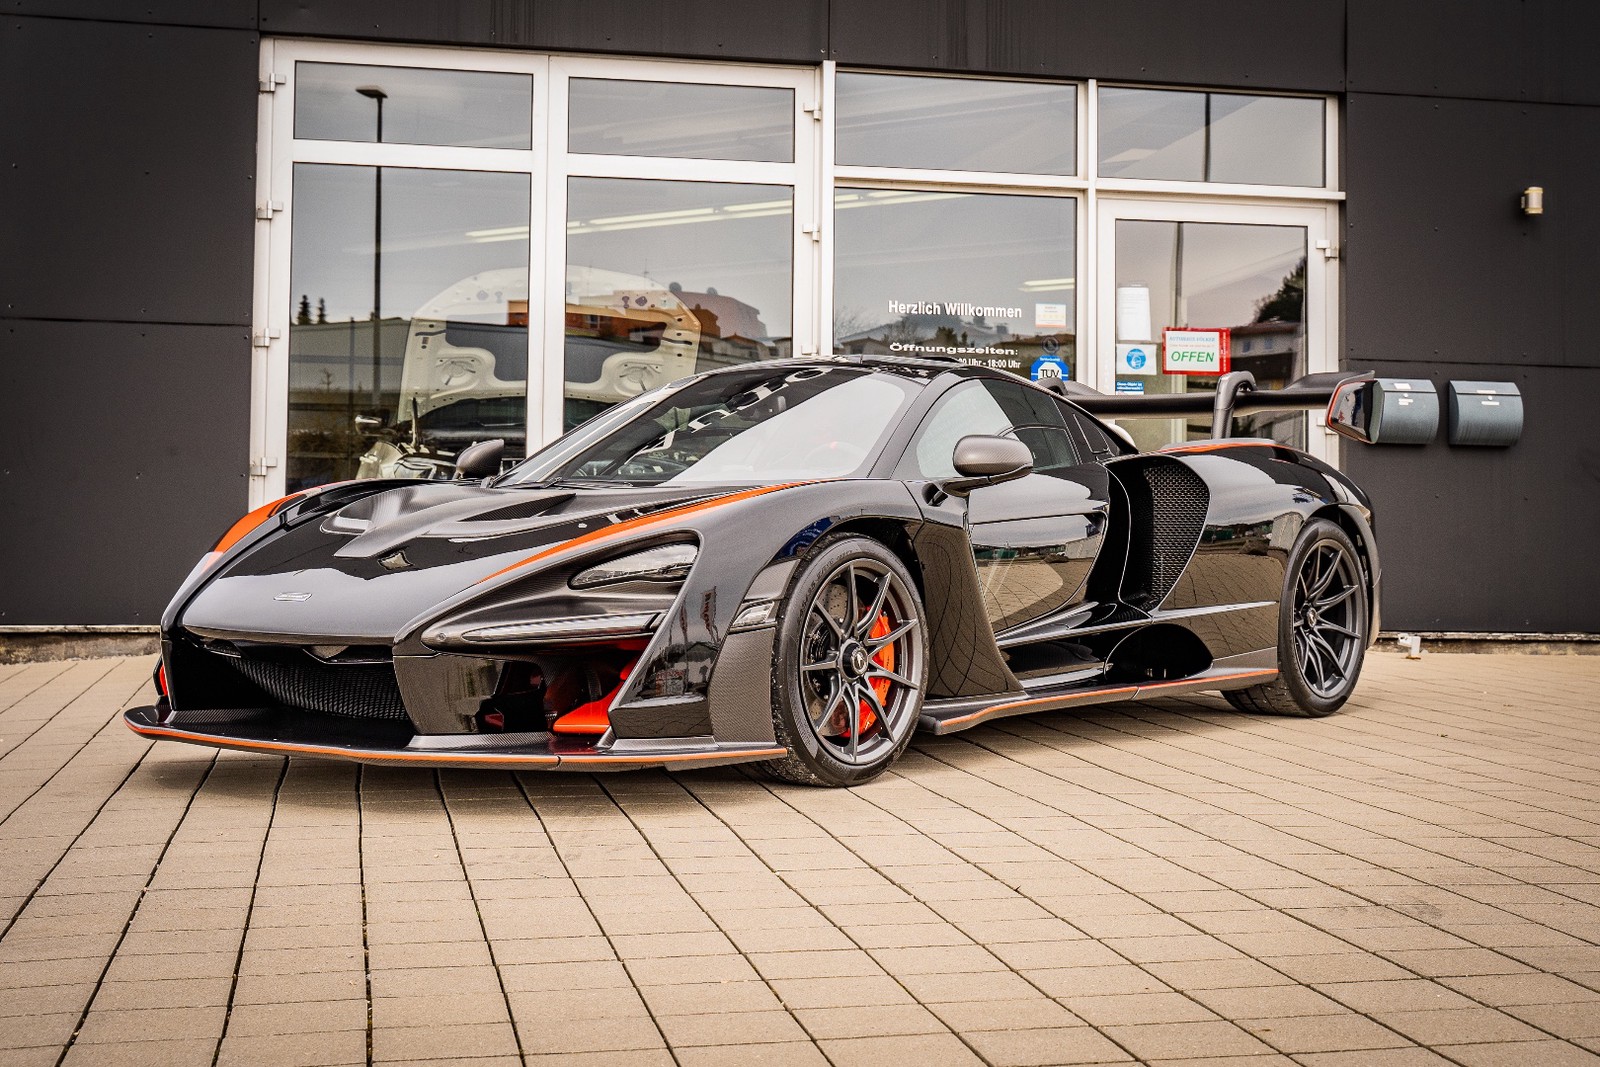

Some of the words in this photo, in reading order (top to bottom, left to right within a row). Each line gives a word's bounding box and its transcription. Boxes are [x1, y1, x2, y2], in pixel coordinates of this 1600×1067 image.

[888, 300, 941, 315] Herzlich
[945, 303, 1022, 318] Willkommen
[889, 342, 1018, 355] Öffnungszeiten:
[968, 358, 982, 366] Uhr
[988, 359, 1007, 368] 18:00
[1008, 360, 1021, 368] Uhr
[1171, 351, 1215, 363] OFFEN
